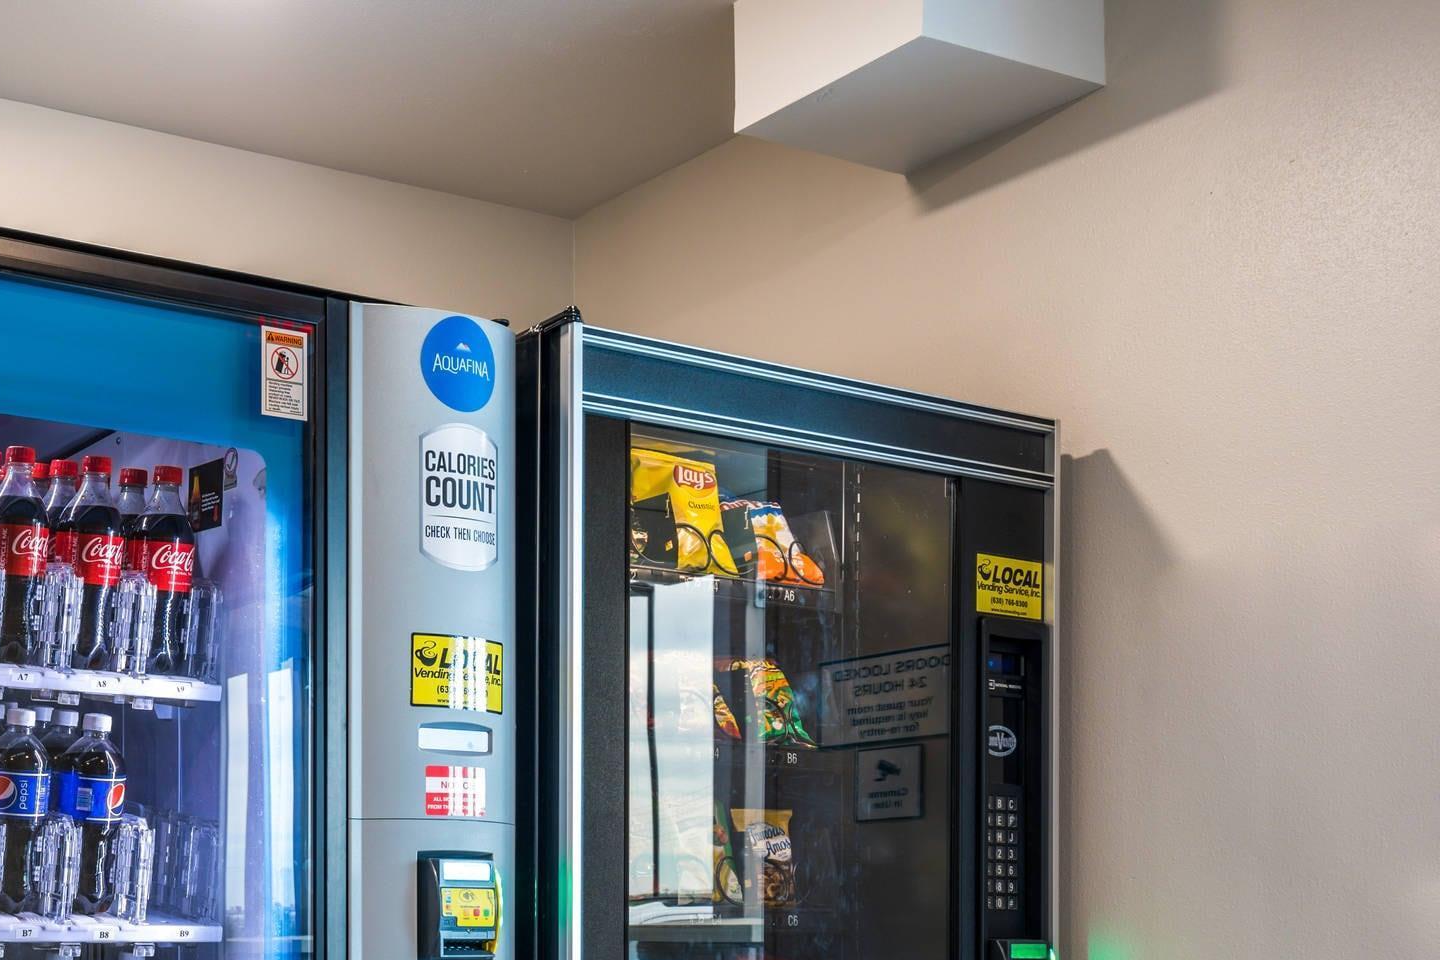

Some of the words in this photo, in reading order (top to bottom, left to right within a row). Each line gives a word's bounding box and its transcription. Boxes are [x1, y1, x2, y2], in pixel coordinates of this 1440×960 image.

[274, 334, 302, 346] WARNING
[432, 353, 490, 381] AQUAFINA
[425, 450, 496, 480] CALORIES
[678, 464, 714, 490] Lay's
[425, 476, 495, 514] COUNT
[689, 501, 715, 511] Classic
[425, 525, 450, 539] CHECK
[454, 528, 471, 541] THEN
[473, 531, 496, 546] CHOOSE
[992, 565, 1040, 588] LOCAL
[784, 590, 795, 601] A6
[977, 581, 1002, 594] Vending
[1004, 585, 1030, 598] Service,
[17, 673, 29, 681] A7
[415, 668, 453, 681] Vendin
[96, 680, 107, 688] A8
[787, 753, 798, 764] B6
[18, 780, 28, 810] pepsi
[750, 826, 785, 846] Famous
[766, 838, 791, 855] Amos
[22, 928, 33, 937] B7
[99, 930, 110, 939] B8
